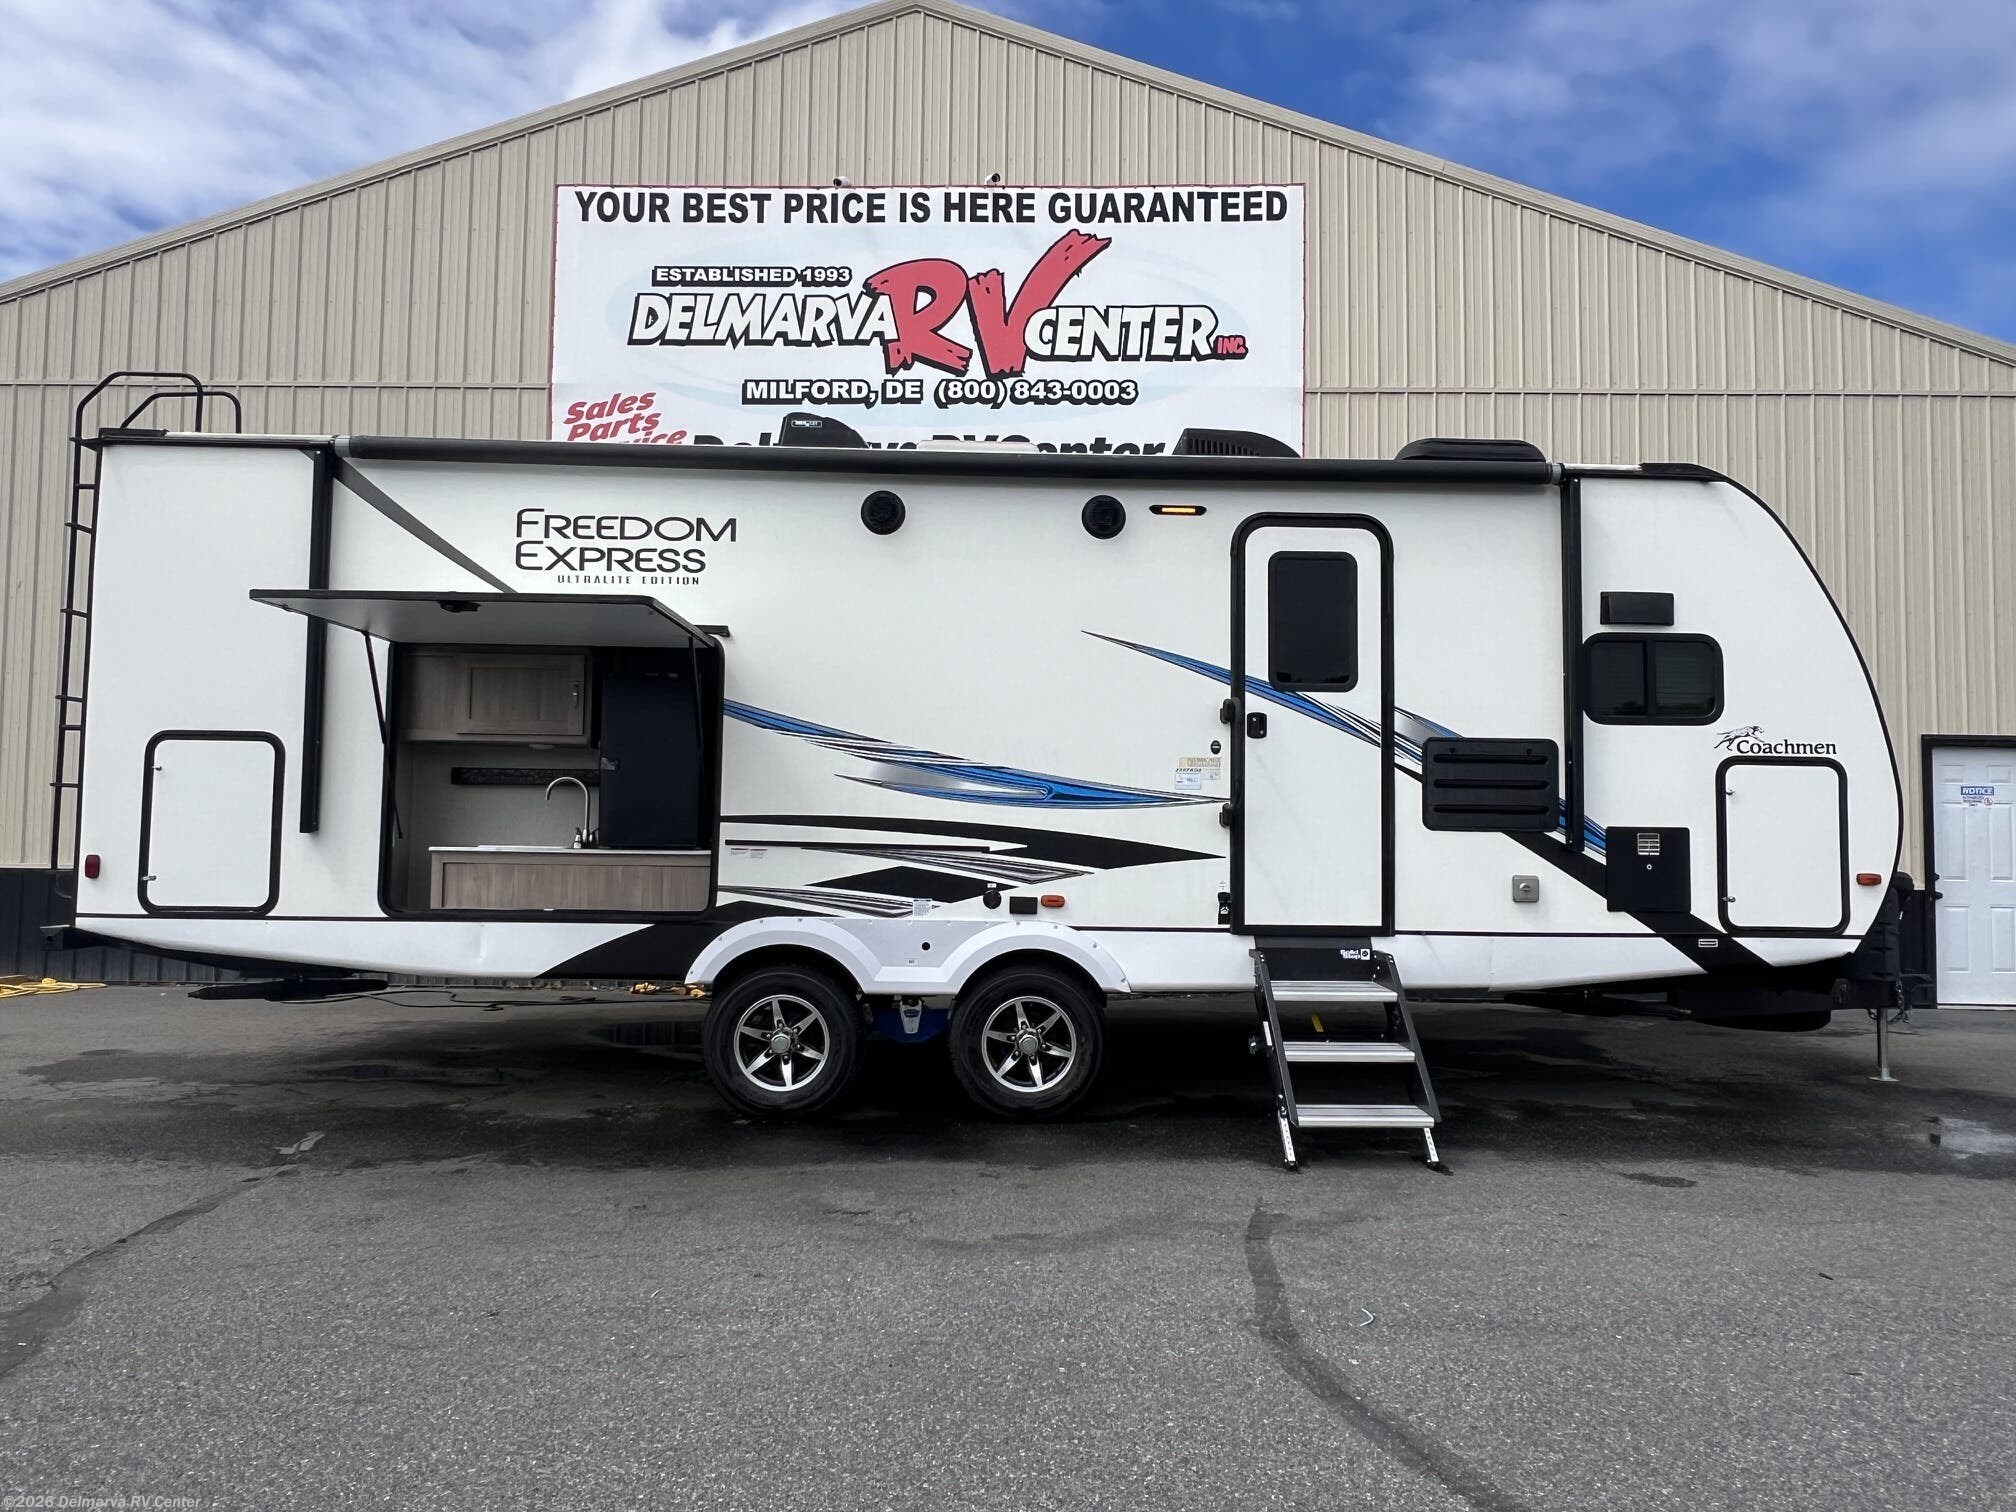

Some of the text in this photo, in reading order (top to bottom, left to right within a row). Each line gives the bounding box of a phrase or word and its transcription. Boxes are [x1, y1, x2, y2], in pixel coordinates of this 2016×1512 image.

[575, 190, 1288, 224] YOUR BEST PRICE IS HERE GUARANTEED
[653, 266, 852, 287] ESTABLISHED 1993
[628, 292, 900, 349] DELMARVA
[864, 229, 1112, 378] RV
[1023, 304, 1218, 361] CENTER
[564, 392, 656, 425] Sales
[742, 379, 1139, 409] MILFORD, DE (800) 843-0003
[567, 413, 661, 441] Parts
[516, 508, 737, 543] FREEDOM
[515, 540, 707, 574] EXPRESS
[557, 575, 700, 586] ULTRALITE EDITION
[1736, 739, 1837, 755] Coachmen
